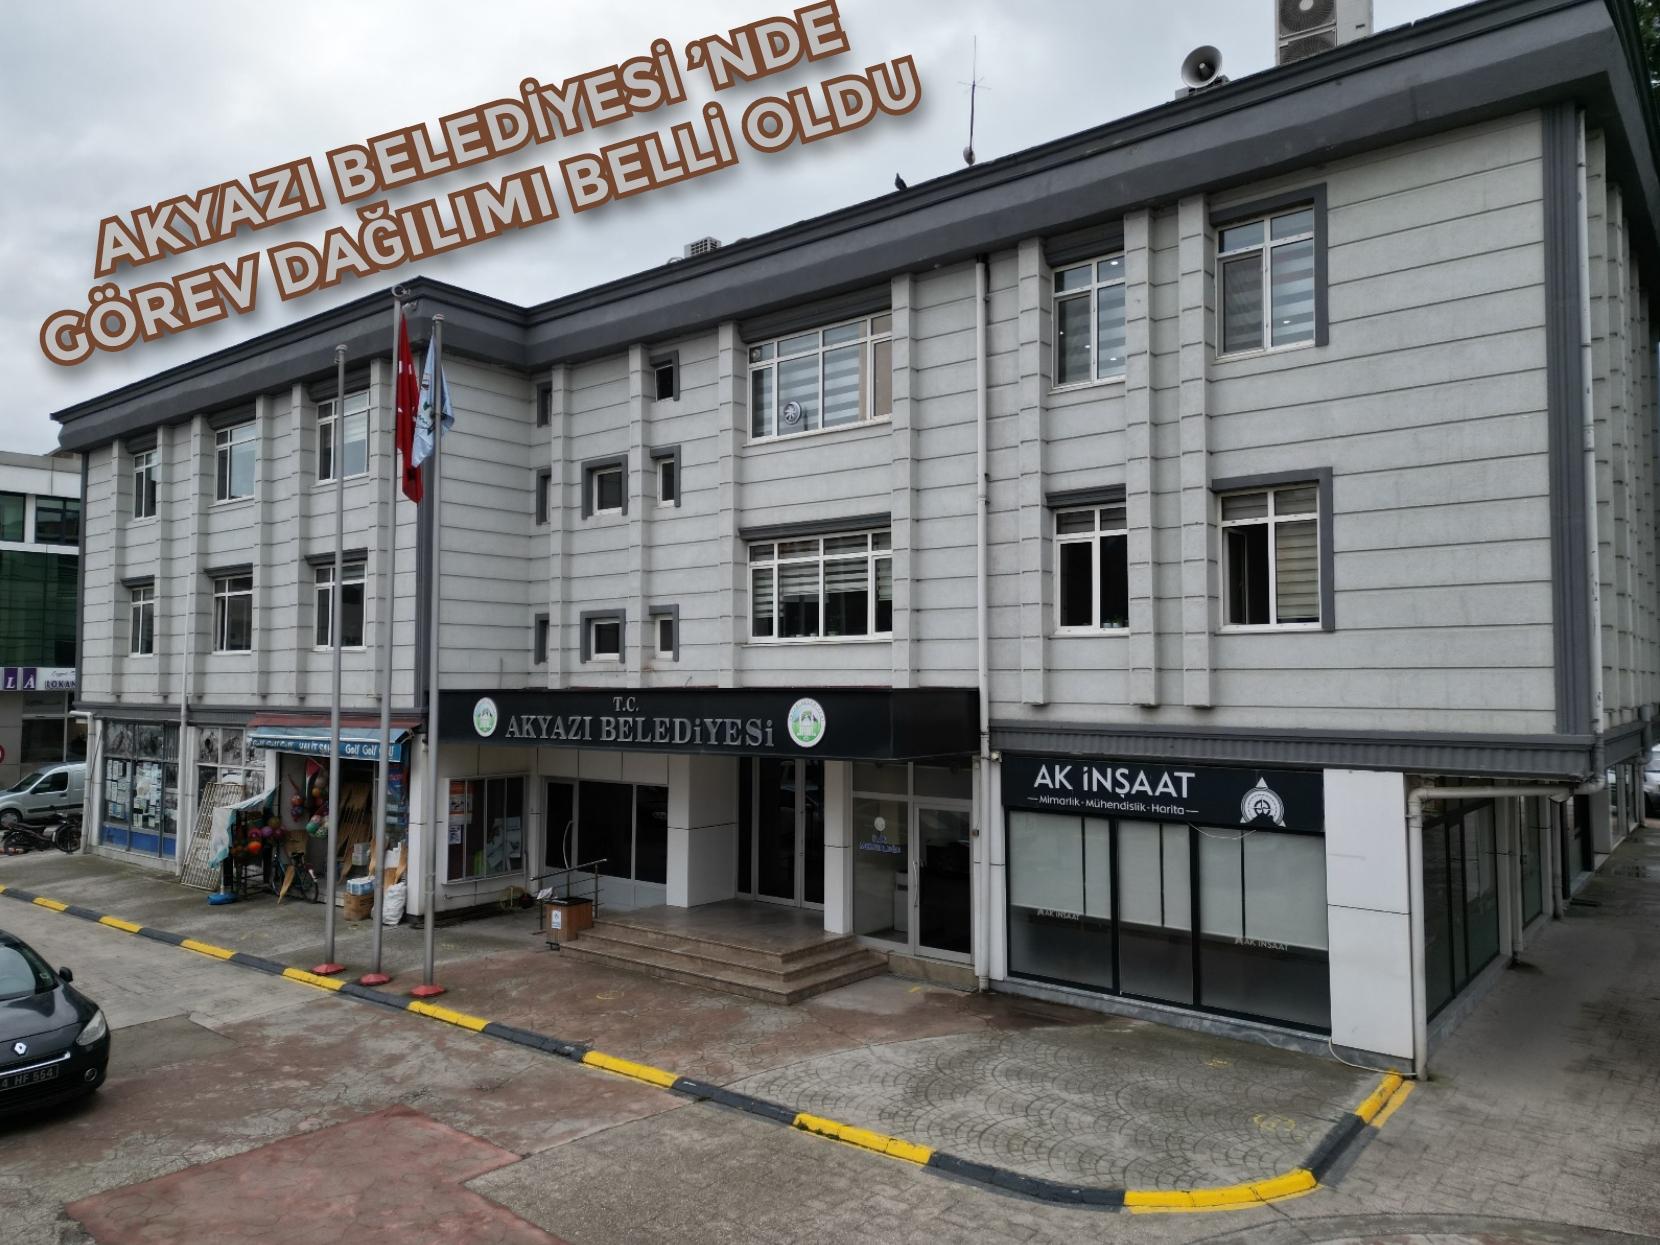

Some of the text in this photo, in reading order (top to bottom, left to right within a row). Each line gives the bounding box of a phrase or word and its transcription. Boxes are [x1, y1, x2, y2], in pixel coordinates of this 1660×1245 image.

[613, 696, 640, 713] T.C.
[505, 715, 593, 741] AKYAZI
[1033, 764, 1074, 790] AK
[1085, 799, 1146, 812] Mühendislik
[1151, 803, 1185, 815] Harita
